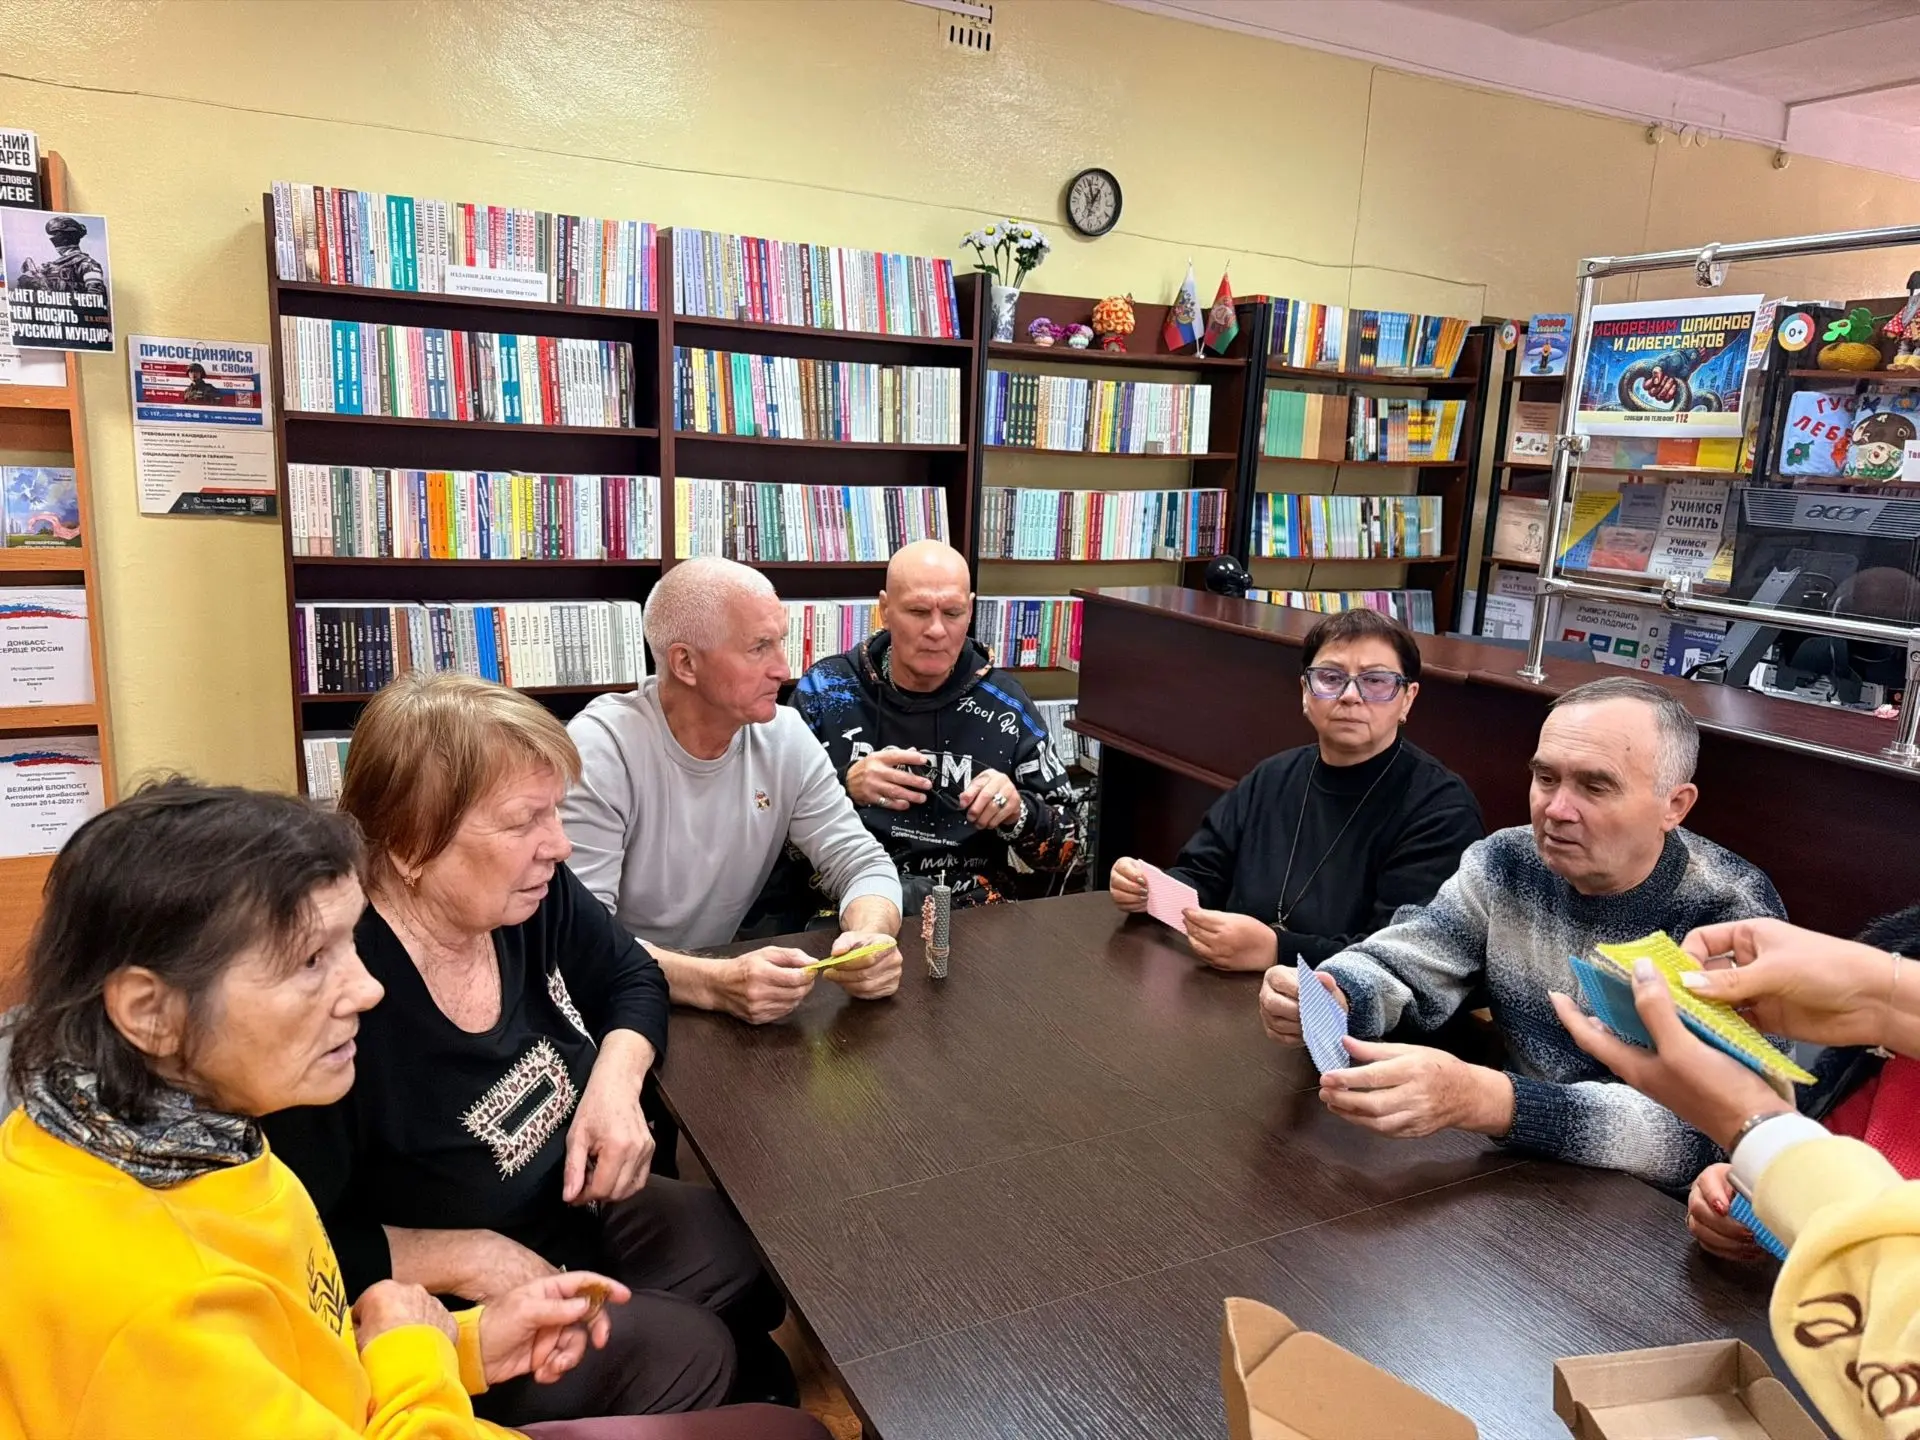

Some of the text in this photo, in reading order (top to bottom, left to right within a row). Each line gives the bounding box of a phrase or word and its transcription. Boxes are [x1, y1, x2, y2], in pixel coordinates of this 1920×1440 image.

[0, 133, 30, 151] НИЙ
[415, 201, 424, 253] КРЕЩЕНИЕ
[426, 203, 435, 255] КРЕЩЕНИЕ
[438, 204, 447, 256] КРЕЩЕНИЕ
[36, 290, 72, 306] ВЫШЕ
[73, 292, 107, 309] ЧЕСТИ,
[9, 305, 32, 320] ЧЕМ
[35, 307, 79, 324] НОСИТЬ
[11, 322, 63, 340] РУССКИЙ
[1593, 314, 1752, 337] ИСКОРЕНИМ ШПИОНОВ
[1789, 328, 1803, 338] 0+
[1613, 332, 1726, 352] И ДИВЕРСАНТОВ
[140, 343, 253, 363] ПРИСОЕДИНЯЙСЯ
[1675, 413, 1689, 423] 112
[581, 487, 589, 516] ОВОД
[1670, 500, 1723, 514] УЧИМСЯ
[1805, 504, 1870, 521] acer
[1667, 515, 1719, 530] СЧИТАТЬ
[1669, 537, 1707, 548] УЧИМСЯ
[1666, 547, 1704, 557] СЧИТАТЬ
[552, 609, 562, 647] ОБЛОМОВ
[580, 608, 589, 646] ОБЛОМОВ
[1576, 614, 1598, 624] СВОЮ
[1684, 629, 1725, 641] ИНФОРМАТИК
[5, 793, 45, 801] Антология
[7, 783, 87, 793] ВЕЛИКИЙ БЛОКПОСТ
